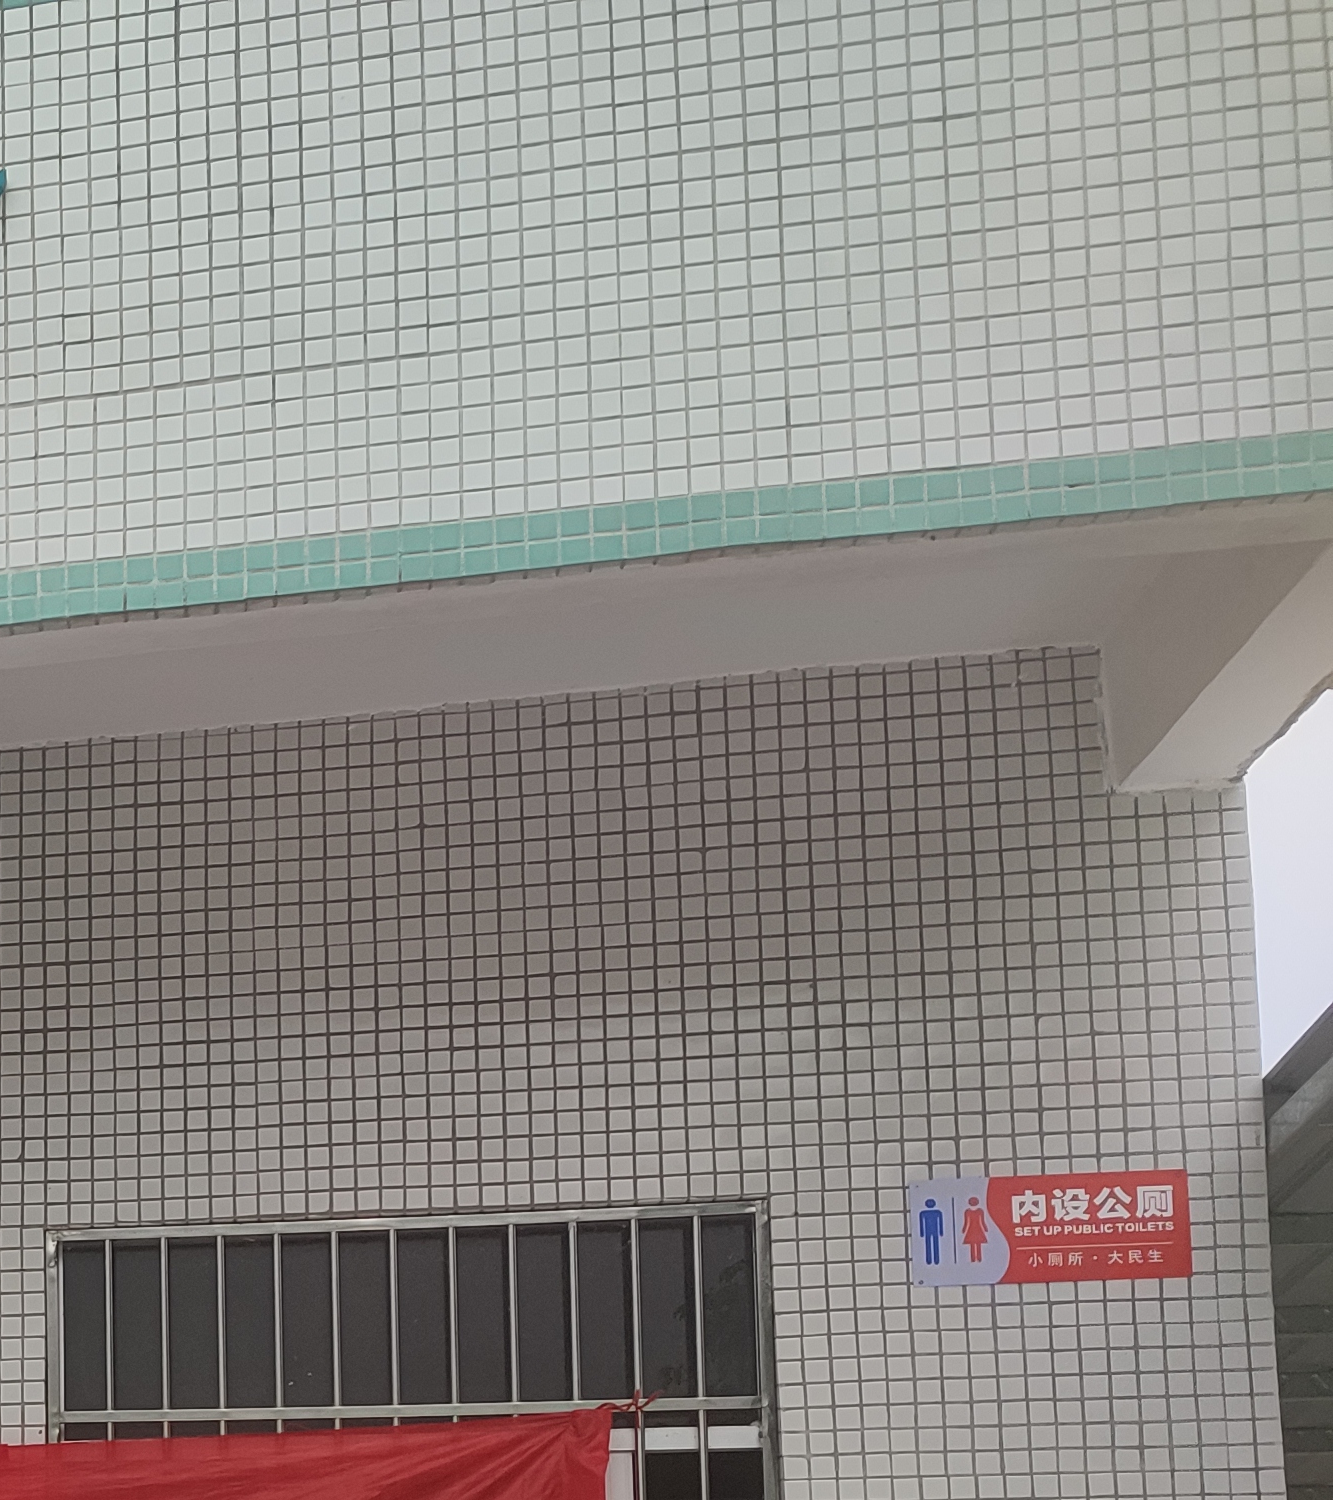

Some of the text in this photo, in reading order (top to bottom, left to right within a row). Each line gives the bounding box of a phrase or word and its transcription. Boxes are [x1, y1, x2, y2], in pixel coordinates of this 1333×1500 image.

[1011, 1185, 1175, 1223] 内设公厕
[1014, 1221, 1175, 1237] SET UP PUBLIC TOILETS
